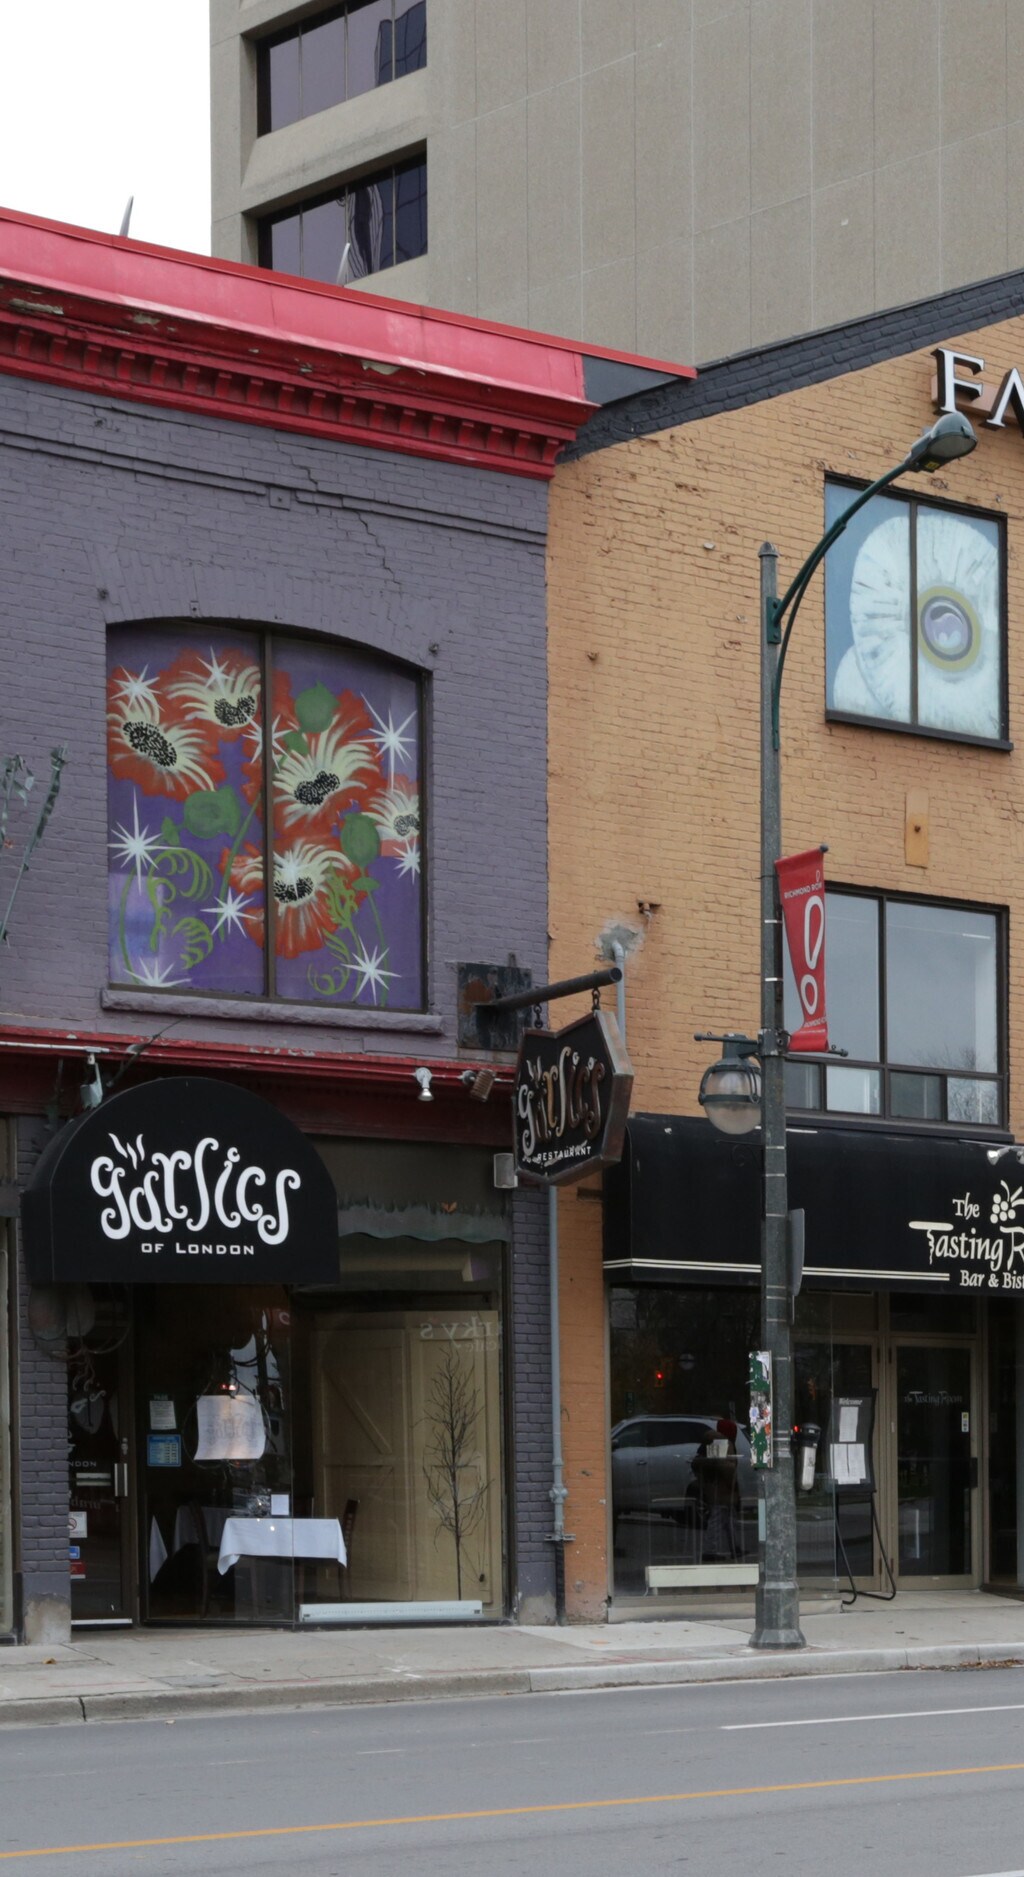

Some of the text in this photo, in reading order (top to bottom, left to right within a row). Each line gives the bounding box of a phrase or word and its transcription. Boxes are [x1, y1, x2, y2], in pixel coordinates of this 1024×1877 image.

[953, 1192, 980, 1220] The
[141, 1242, 254, 1256] OF LONDON
[908, 1221, 1006, 1270] Tasting
[960, 1269, 985, 1289] Bar
[988, 1272, 999, 1288] &
[69, 1460, 97, 1468] NDON
